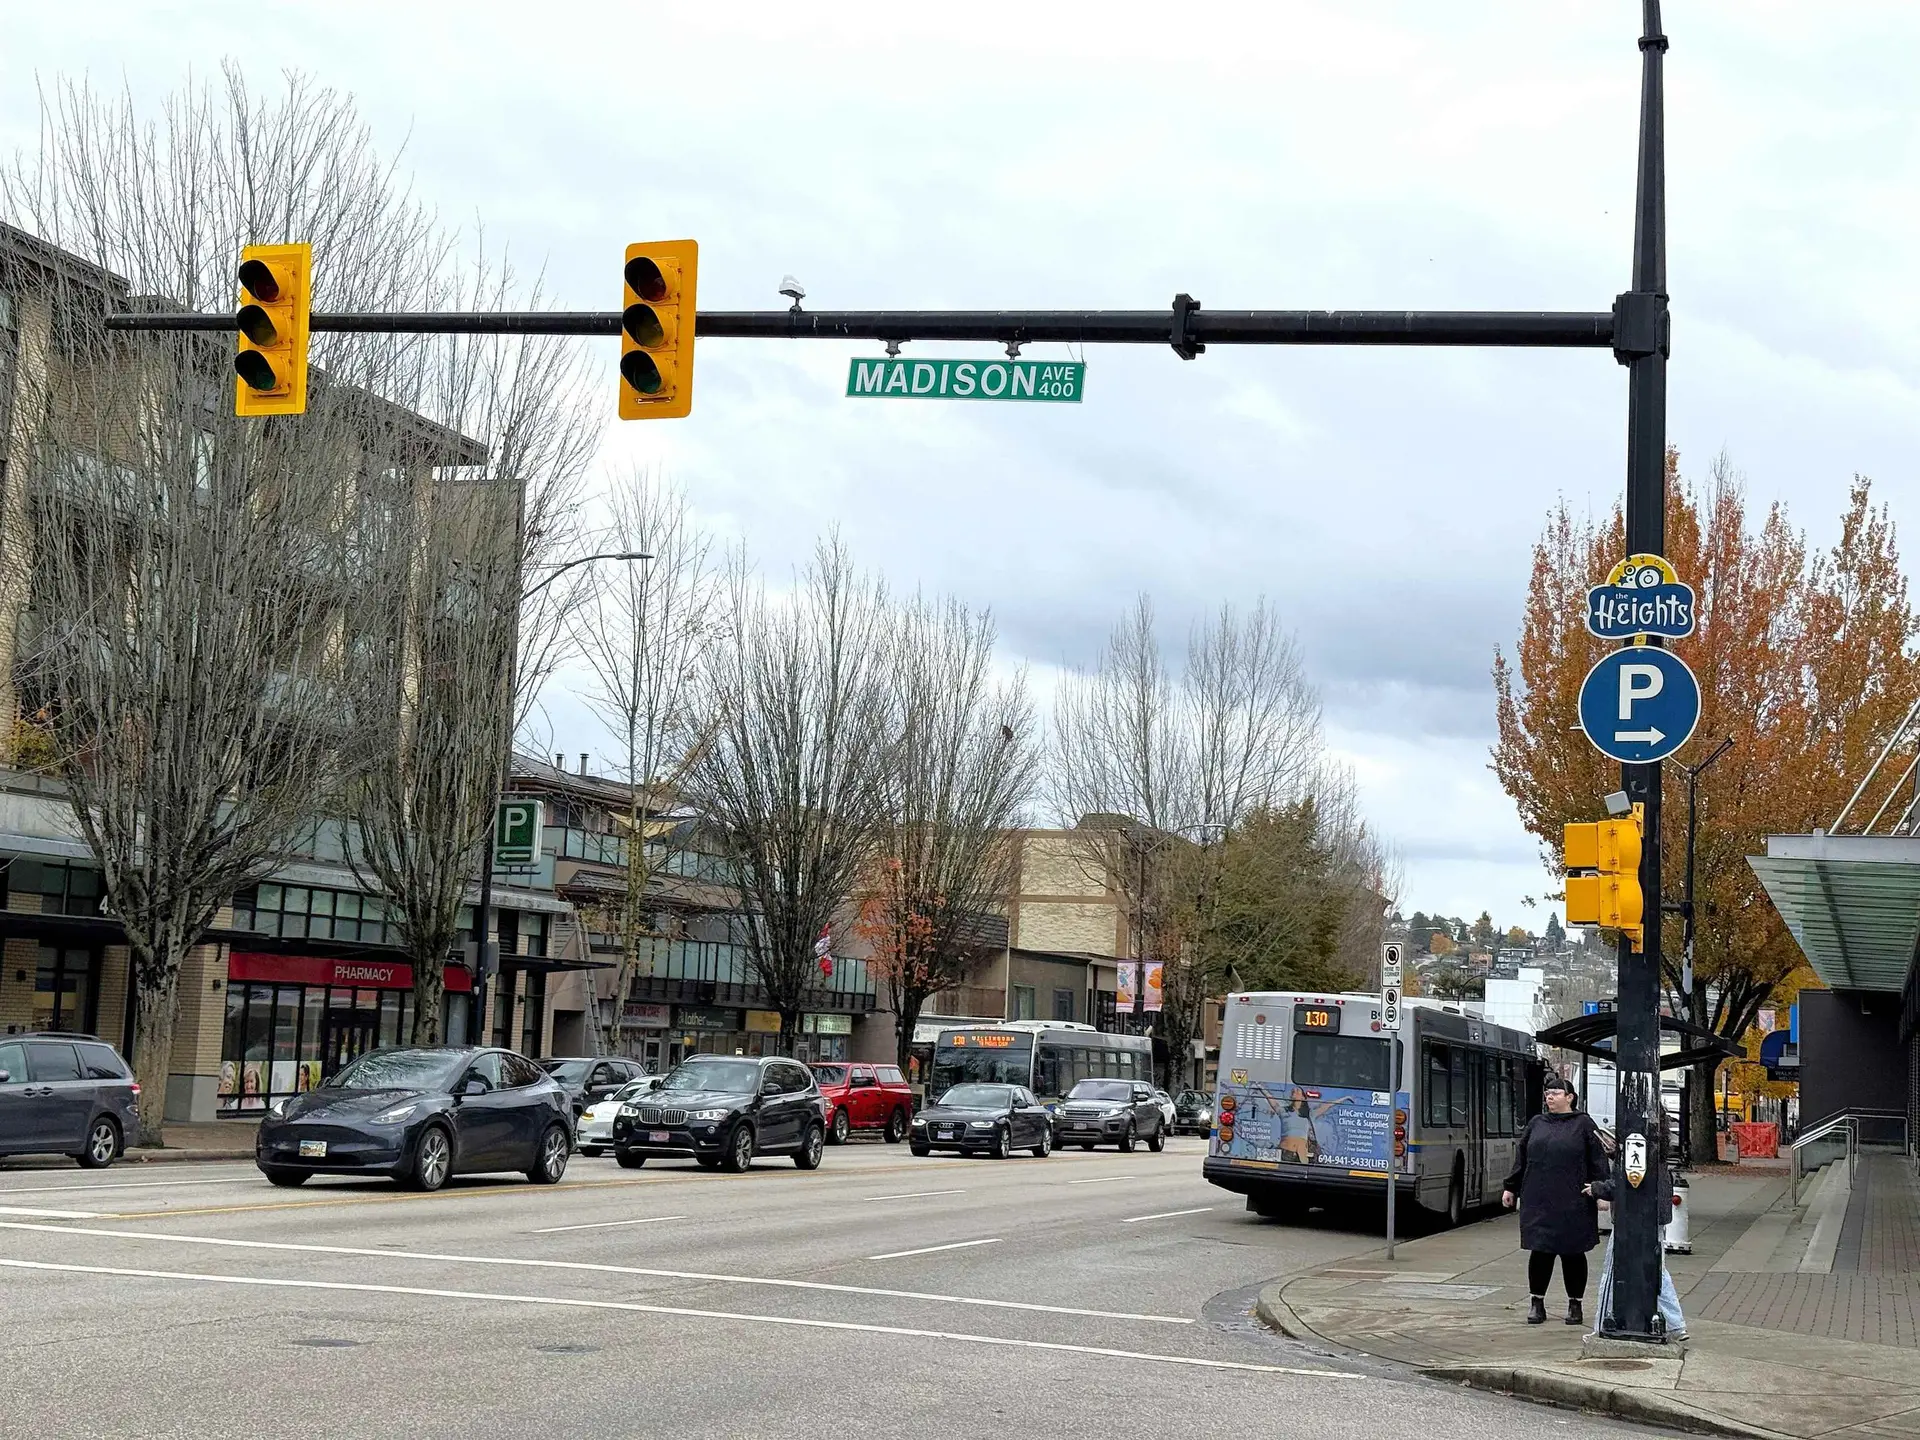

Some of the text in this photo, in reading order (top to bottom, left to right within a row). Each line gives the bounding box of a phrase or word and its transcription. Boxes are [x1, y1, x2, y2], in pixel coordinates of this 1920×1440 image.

[855, 362, 1075, 397] MADISON AVE
[1038, 382, 1075, 397] 400
[1615, 592, 1629, 600] the
[1594, 594, 1689, 629] Heights
[1618, 664, 1664, 720] P
[504, 807, 528, 843] P
[334, 965, 394, 981] PHARMACY
[1305, 1010, 1328, 1026] 130
[1338, 1109, 1390, 1121] LifeCare Ostomy
[1338, 1118, 1356, 1126] Clinic
[1363, 1120, 1389, 1130] Supplies
